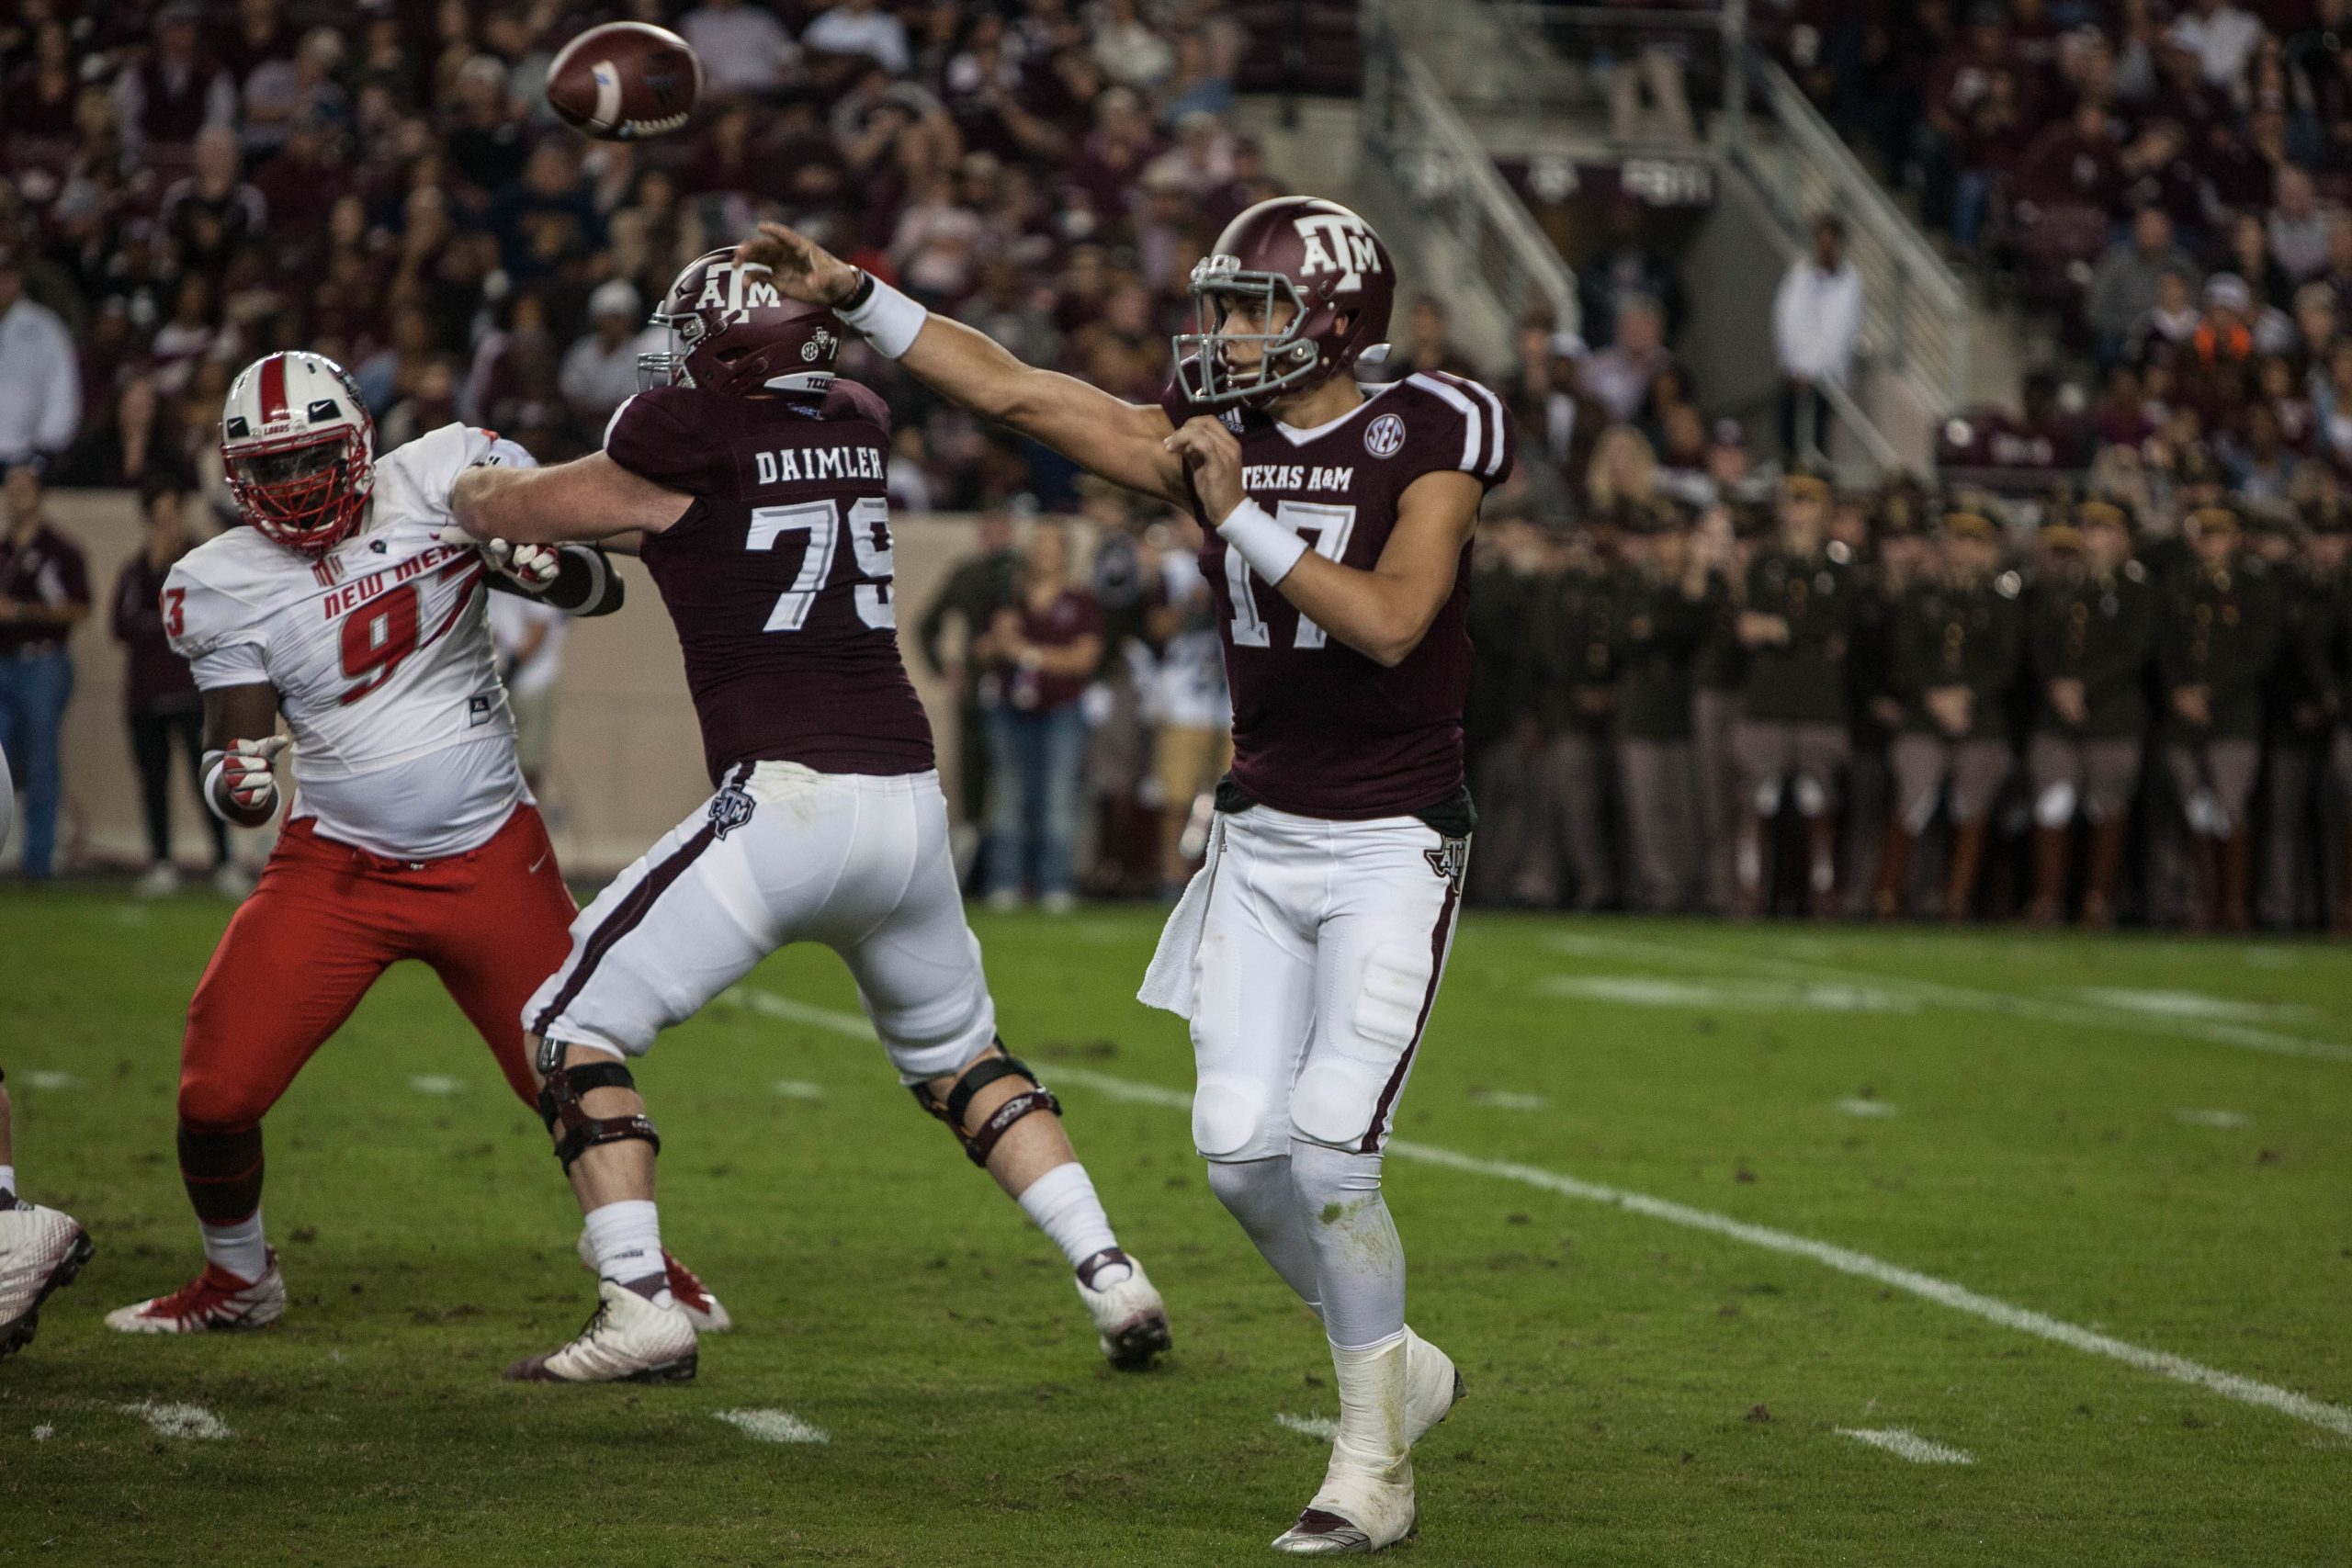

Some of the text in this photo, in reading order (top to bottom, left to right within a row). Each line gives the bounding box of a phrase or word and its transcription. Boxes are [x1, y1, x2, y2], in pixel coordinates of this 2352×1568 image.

[264, 423, 290, 435] LOBOS
[1367, 416, 1403, 454] SEC
[755, 446, 884, 485] DAIMLER
[1241, 464, 1354, 492] TEXAS A&M
[745, 497, 897, 632] 79
[1224, 500, 1357, 649] 17
[324, 573, 384, 619] NEW
